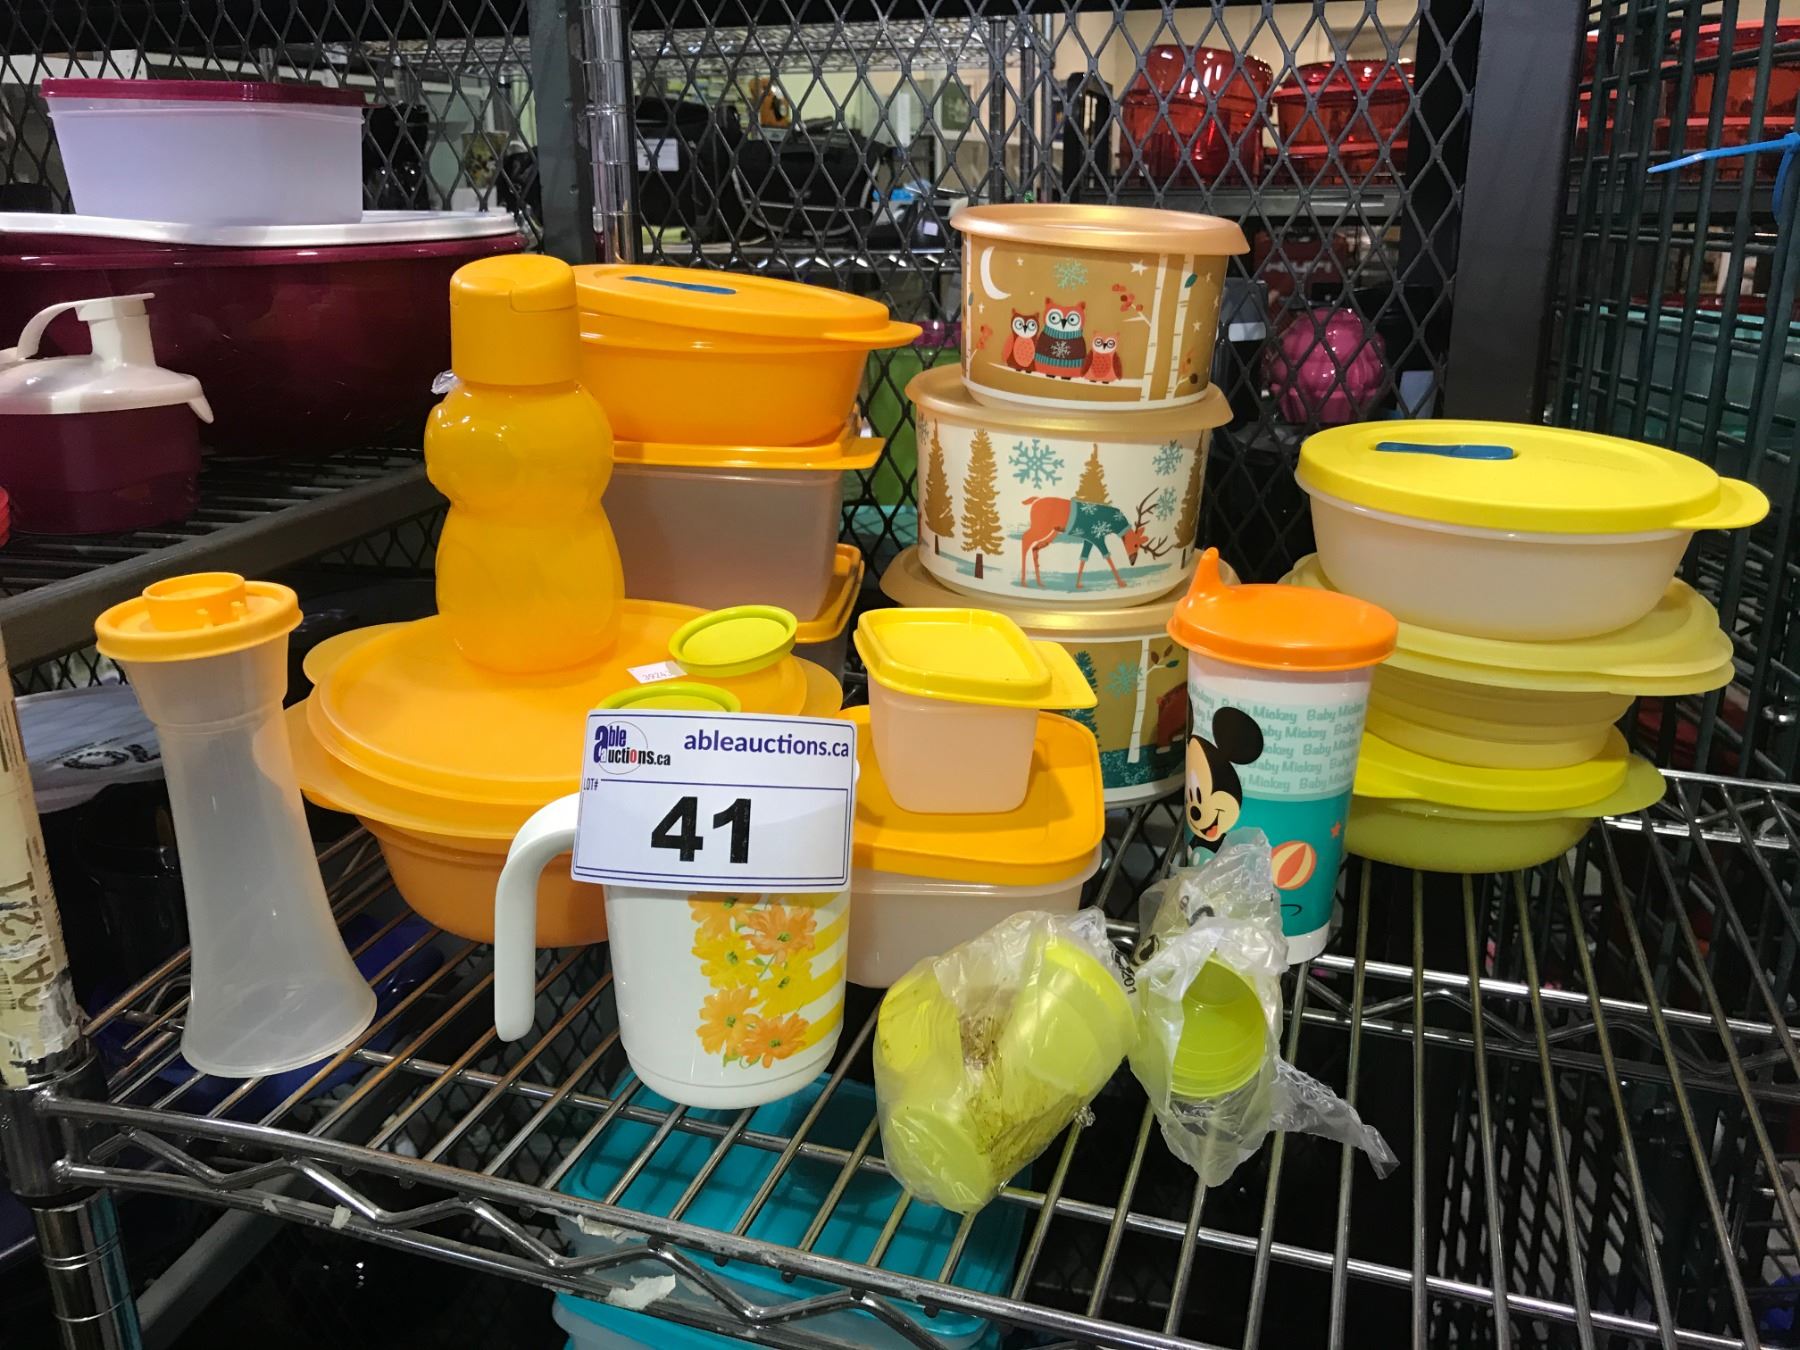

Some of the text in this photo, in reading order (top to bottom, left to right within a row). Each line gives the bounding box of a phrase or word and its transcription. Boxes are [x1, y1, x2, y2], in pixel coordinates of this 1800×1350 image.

[1253, 705, 1297, 725] Mickey
[1307, 708, 1336, 723] Baby
[1285, 726, 1327, 740] Mickey
[594, 725, 627, 763] able
[684, 729, 849, 757] ableauctions.ca
[1303, 743, 1331, 758] Baby
[1282, 760, 1322, 775] Mickey
[583, 777, 599, 791] LOT#
[1249, 775, 1290, 792] Mickey
[1300, 777, 1327, 791] Baby
[651, 796, 751, 864] 41
